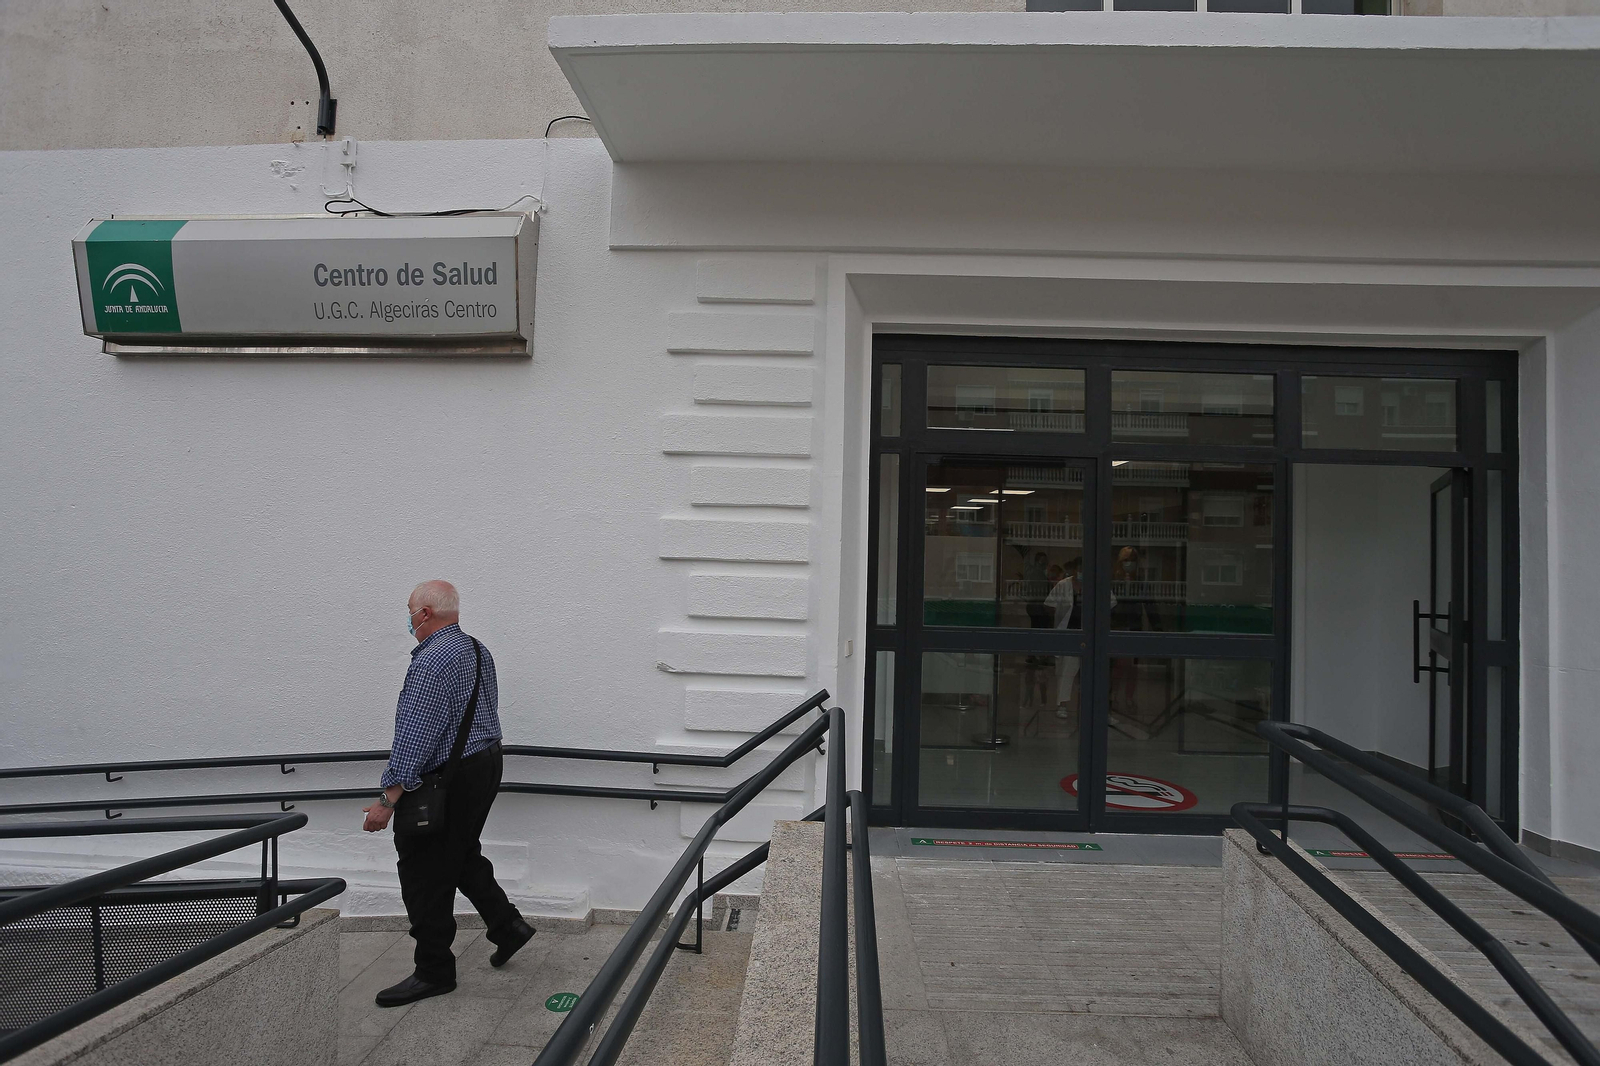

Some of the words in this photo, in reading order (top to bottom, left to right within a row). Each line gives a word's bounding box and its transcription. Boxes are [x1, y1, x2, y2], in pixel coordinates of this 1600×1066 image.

[313, 263, 389, 287] Centro
[396, 262, 425, 286] de
[432, 261, 498, 286] Salud
[104, 305, 124, 313] JUNTA
[125, 305, 134, 313] DE
[313, 301, 364, 320] U.G.C.
[444, 299, 497, 318] Centro
